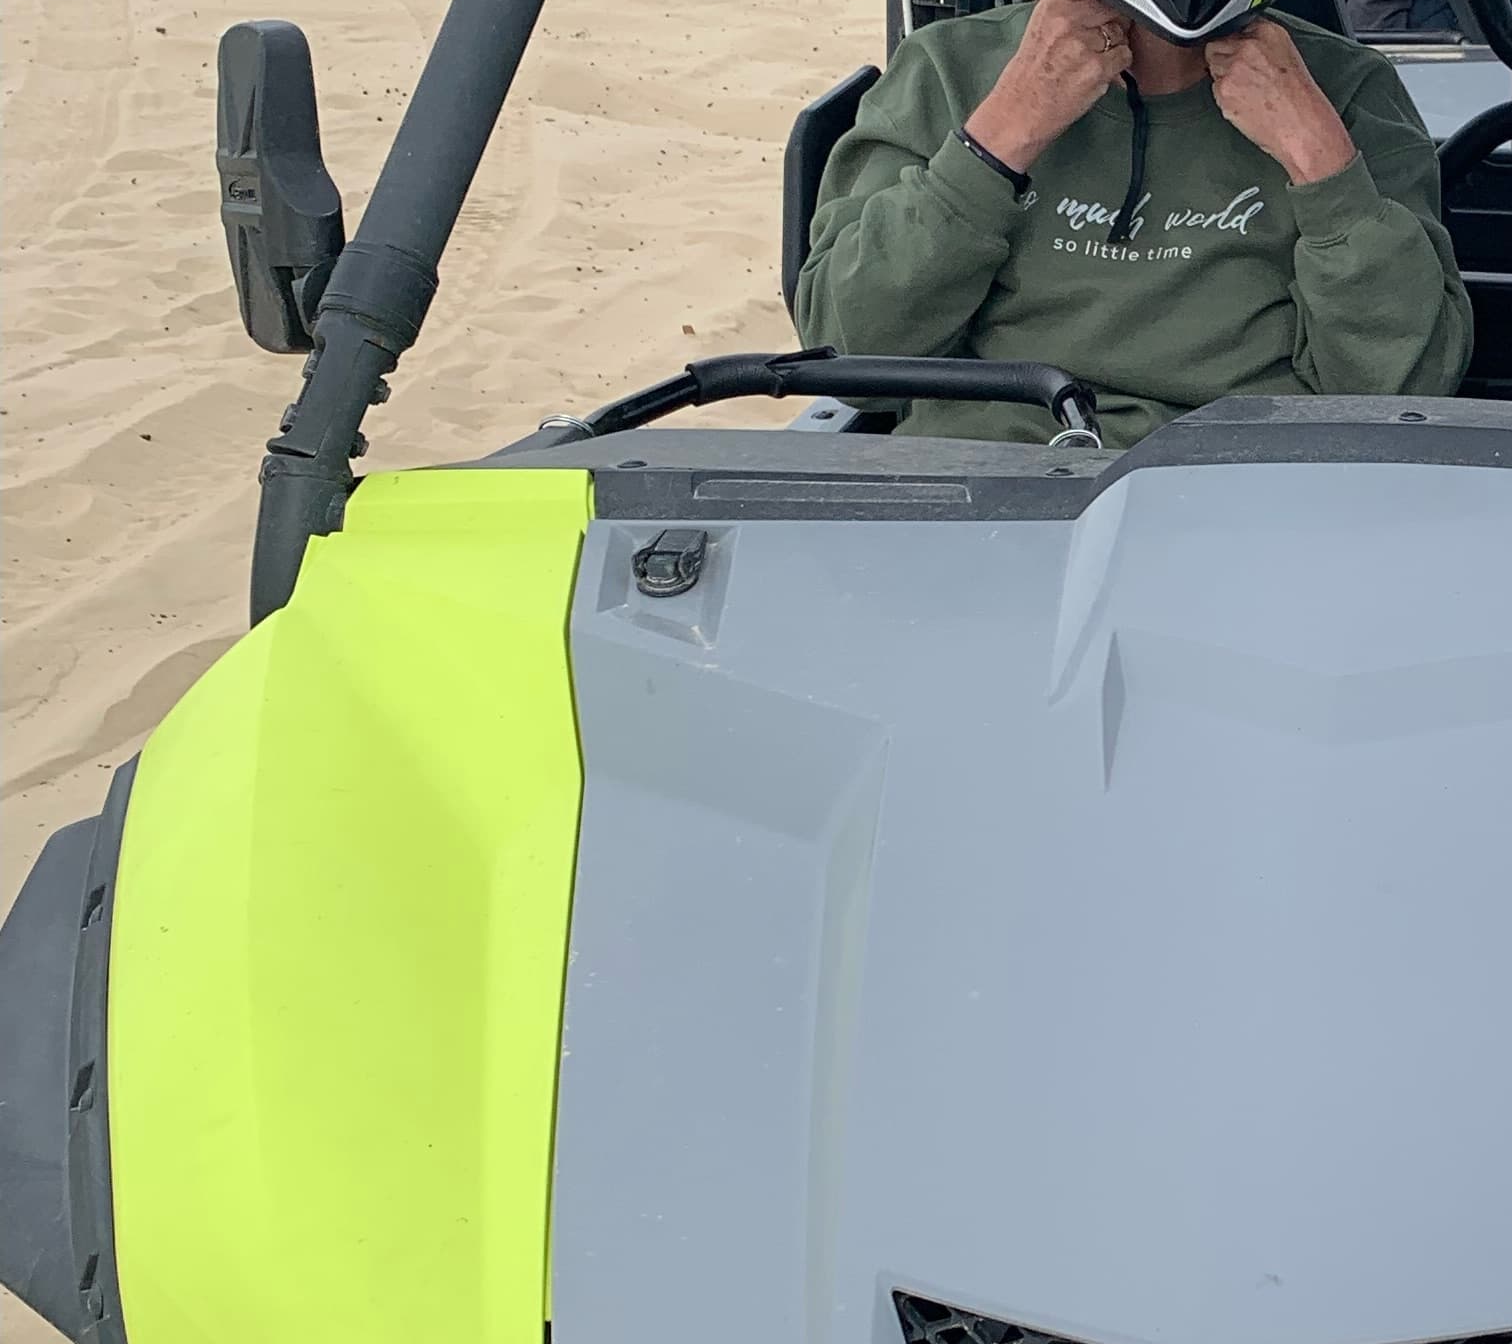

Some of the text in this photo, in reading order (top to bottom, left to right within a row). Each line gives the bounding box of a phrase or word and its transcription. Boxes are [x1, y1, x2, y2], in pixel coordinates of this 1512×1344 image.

[1164, 186, 1264, 235] world
[1052, 237, 1193, 262] so little time
